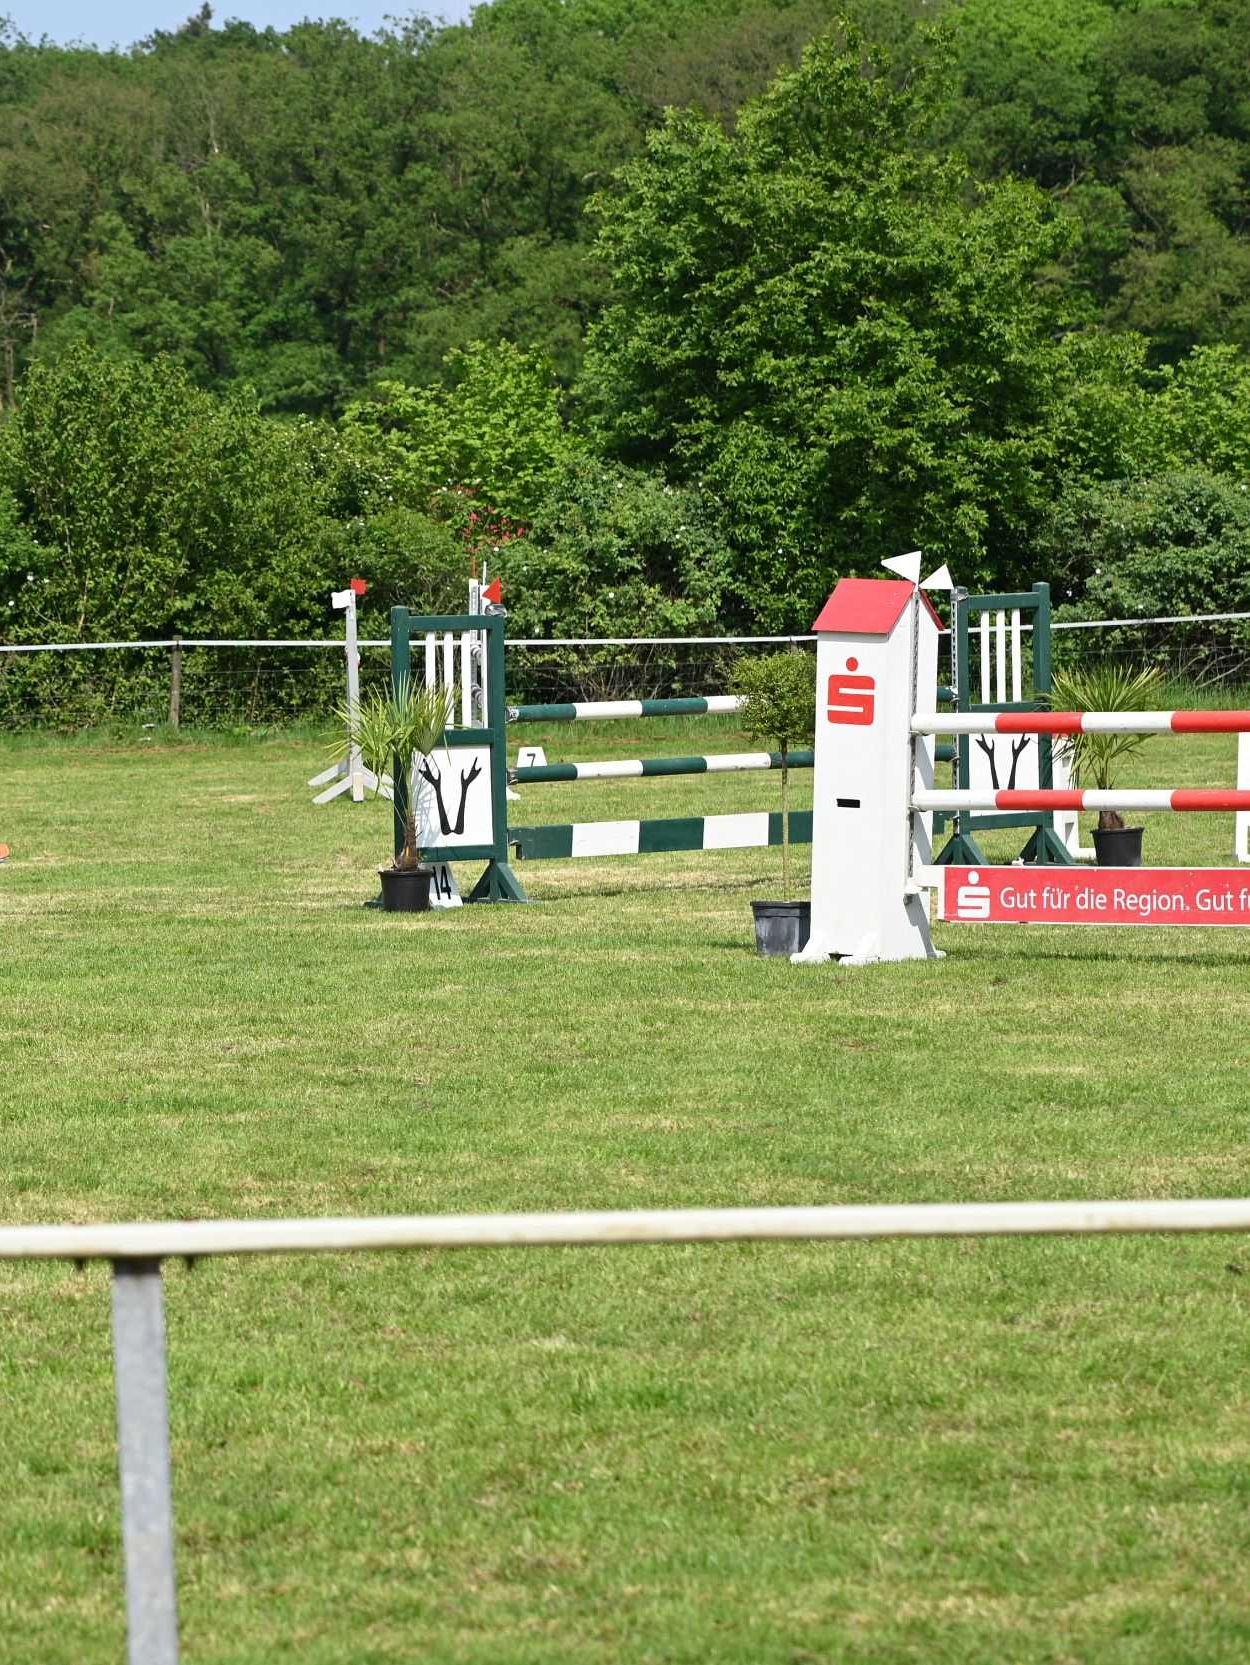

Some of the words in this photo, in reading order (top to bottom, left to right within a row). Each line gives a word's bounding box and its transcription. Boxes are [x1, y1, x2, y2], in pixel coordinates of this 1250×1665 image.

[526, 753, 536, 769] 7
[430, 865, 452, 900] 14
[1000, 887, 1037, 909] Gut
[1042, 886, 1071, 910] für
[1076, 887, 1107, 910] die
[1113, 888, 1190, 916] Region.
[1195, 888, 1234, 912] Gut
